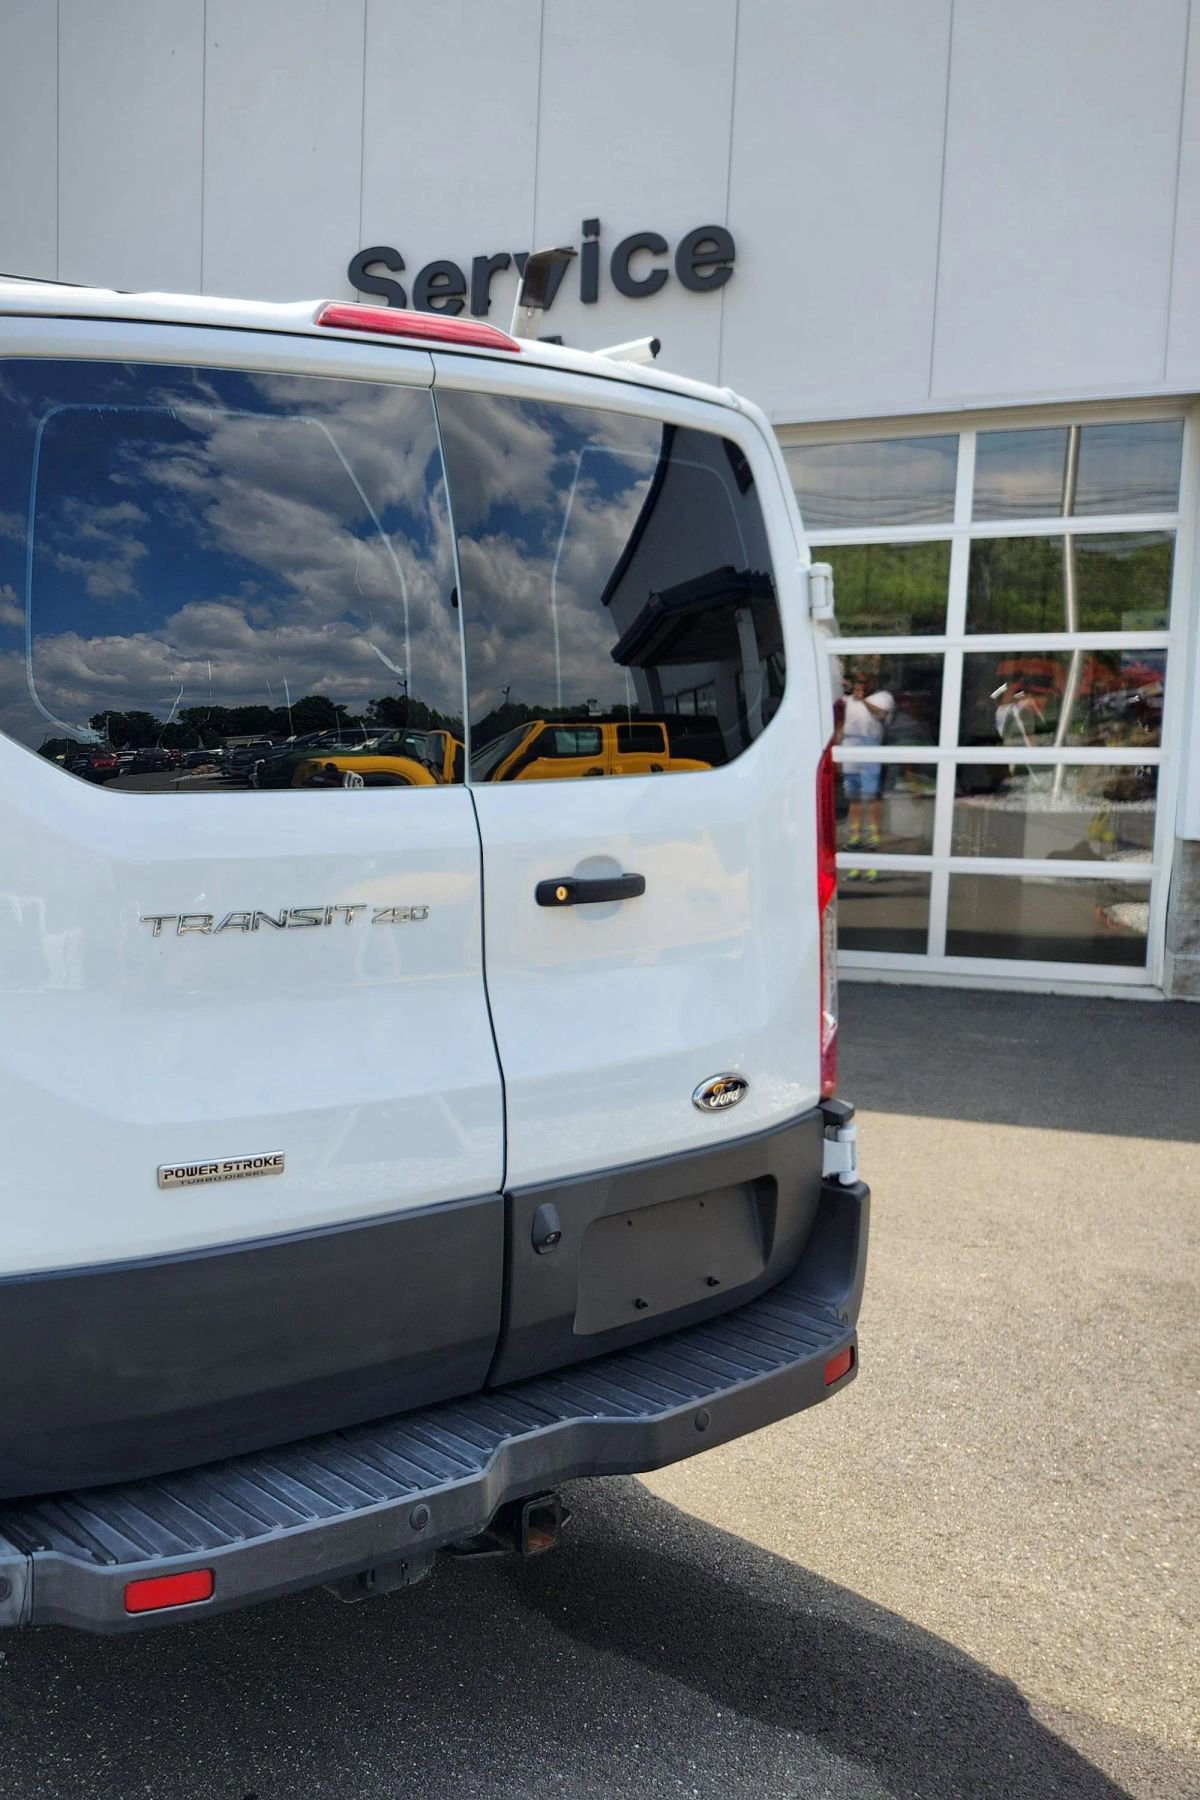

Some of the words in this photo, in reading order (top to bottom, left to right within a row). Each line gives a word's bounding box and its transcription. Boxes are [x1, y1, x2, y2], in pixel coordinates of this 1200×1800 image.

[347, 217, 737, 316] Service
[140, 902, 368, 938] TRANSIT
[371, 904, 431, 924] 250
[163, 1164, 219, 1180] POWER
[223, 1155, 283, 1173] STROKE
[224, 1170, 268, 1180] DIESEL
